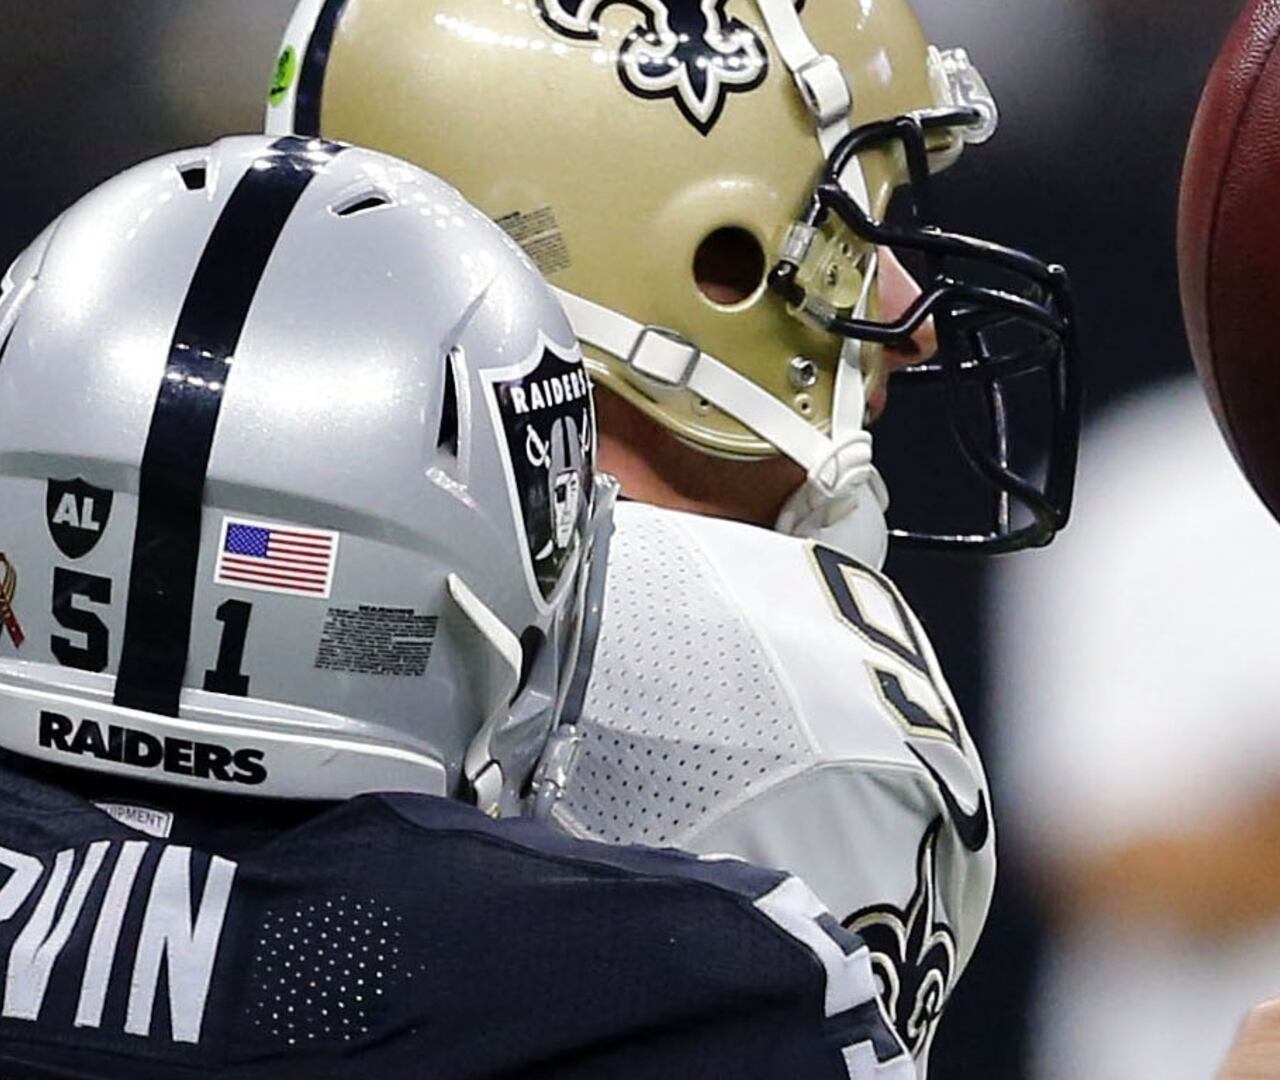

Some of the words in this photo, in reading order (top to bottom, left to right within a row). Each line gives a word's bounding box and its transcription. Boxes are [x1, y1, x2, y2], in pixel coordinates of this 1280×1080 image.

[509, 367, 587, 415] RAIDERS
[52, 492, 101, 532] AL
[50, 565, 113, 674] 5
[203, 598, 252, 697] 1
[38, 710, 268, 786] RAIDERS
